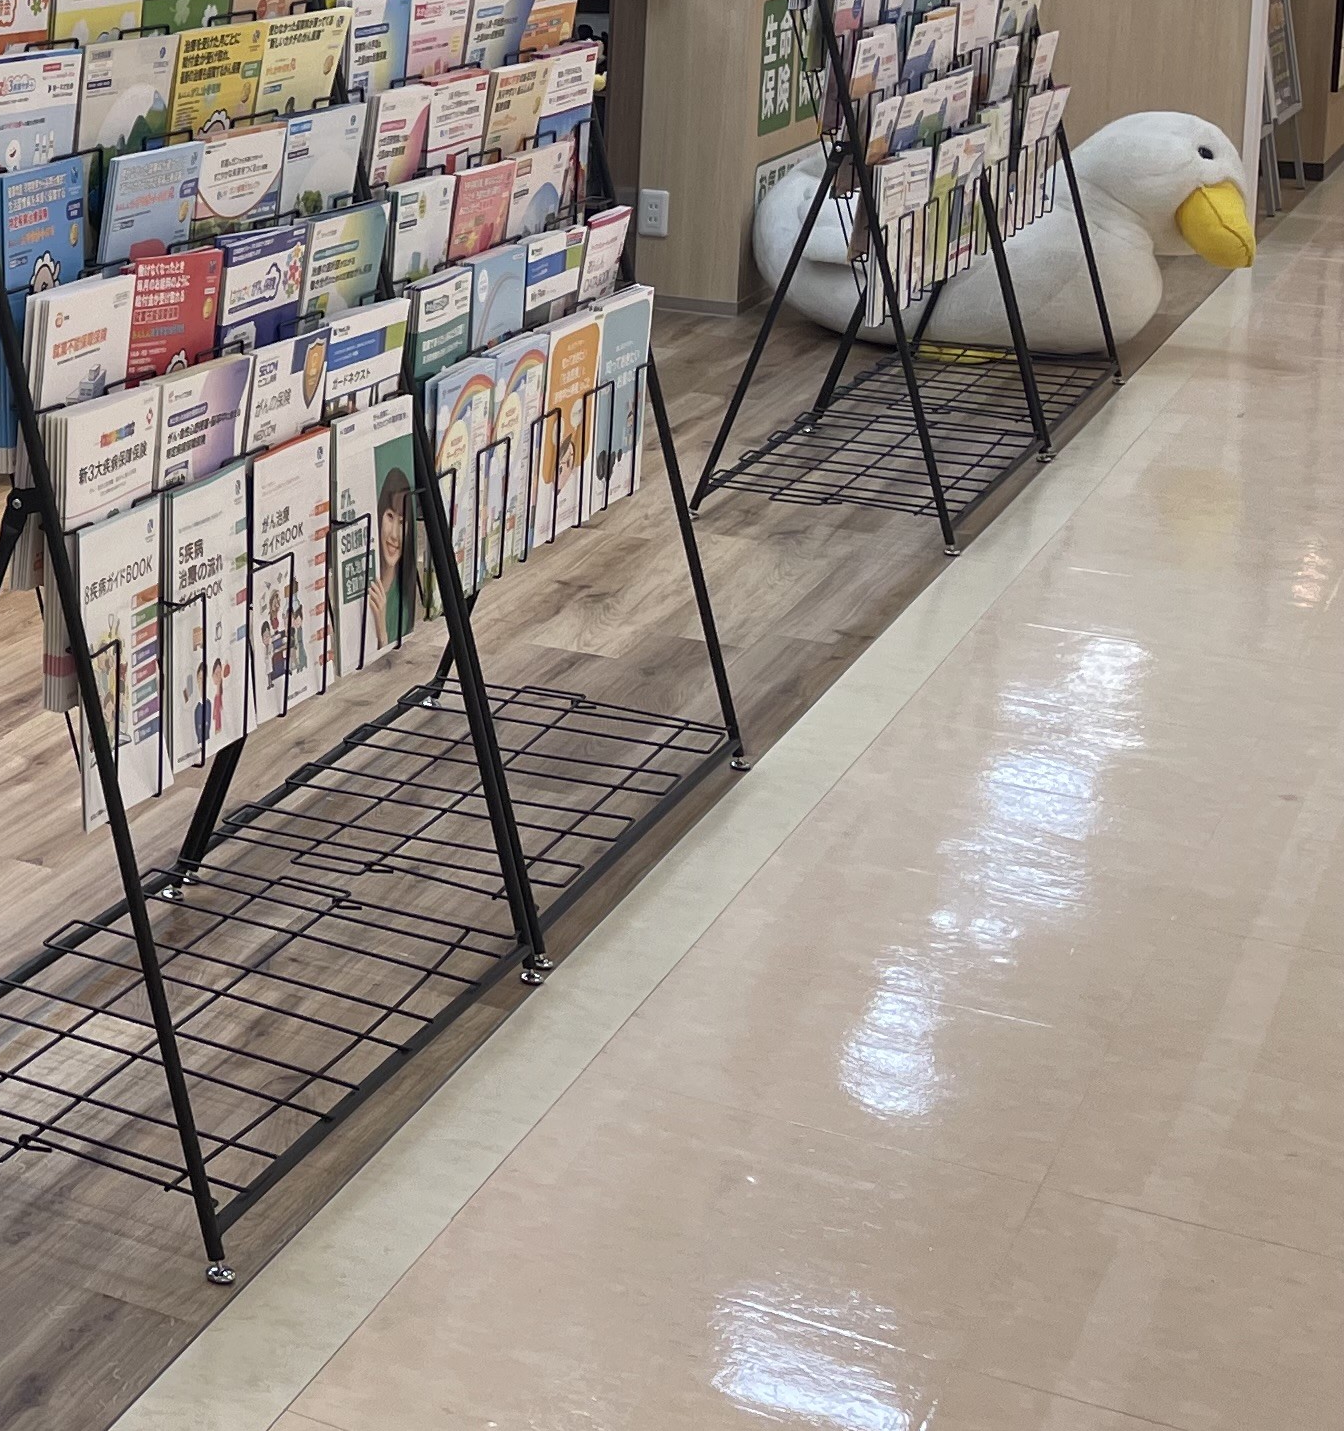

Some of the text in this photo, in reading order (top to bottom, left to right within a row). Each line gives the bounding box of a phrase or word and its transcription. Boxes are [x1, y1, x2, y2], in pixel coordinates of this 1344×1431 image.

[764, 10, 793, 64] 生命
[762, 63, 790, 120] 保険
[261, 505, 291, 534] がん治療
[179, 538, 204, 565] 5疾病
[261, 521, 304, 557] ガイドBOOK
[84, 554, 153, 606] 8疾病ガイドBOOK
[178, 553, 223, 590] 治療の流れ
